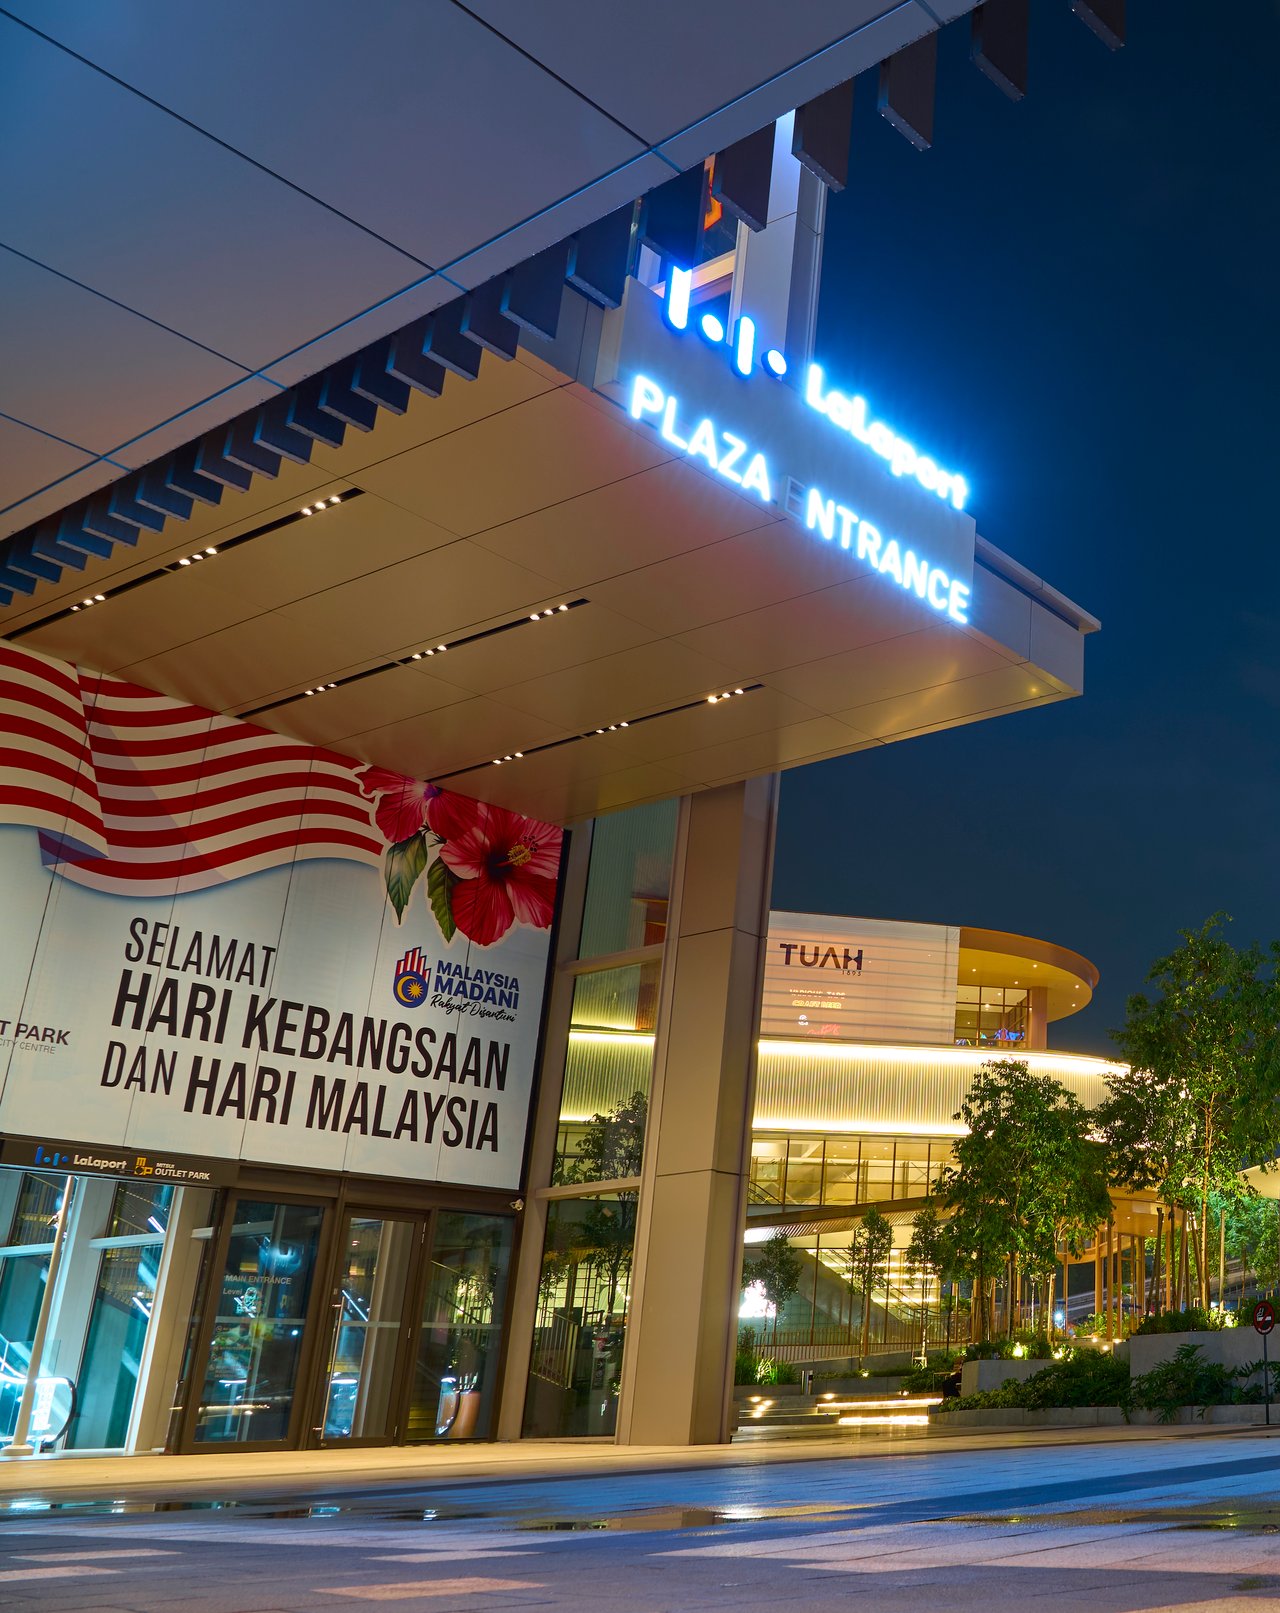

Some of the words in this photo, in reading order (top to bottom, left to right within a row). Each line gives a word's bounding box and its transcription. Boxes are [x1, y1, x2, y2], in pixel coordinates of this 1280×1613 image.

[805, 362, 969, 511] LaLaport
[630, 374, 772, 503] PLAZA
[784, 474, 971, 625] ENTRANCE
[124, 917, 277, 988] SELAMAT
[779, 943, 864, 971] TUAH
[436, 959, 520, 992] MALAYSIA
[430, 993, 471, 1016] Rakyat
[433, 974, 520, 1010] MADANI
[15, 1022, 71, 1046] PARK
[111, 968, 235, 1045] HARI
[241, 994, 511, 1092] KEBANGSAAN
[19, 1041, 57, 1055] CENTRE
[100, 1041, 179, 1096] DAN
[183, 1055, 296, 1126] HARI
[305, 1074, 499, 1153] MALAYSIA
[73, 1154, 128, 1170] LaLaport
[154, 1168, 187, 1179] OUTLET
[188, 1171, 211, 1181] PARK
[222, 1287, 243, 1295] Level
[225, 1274, 247, 1283] MAIN
[248, 1275, 292, 1285] ENTRANCE
